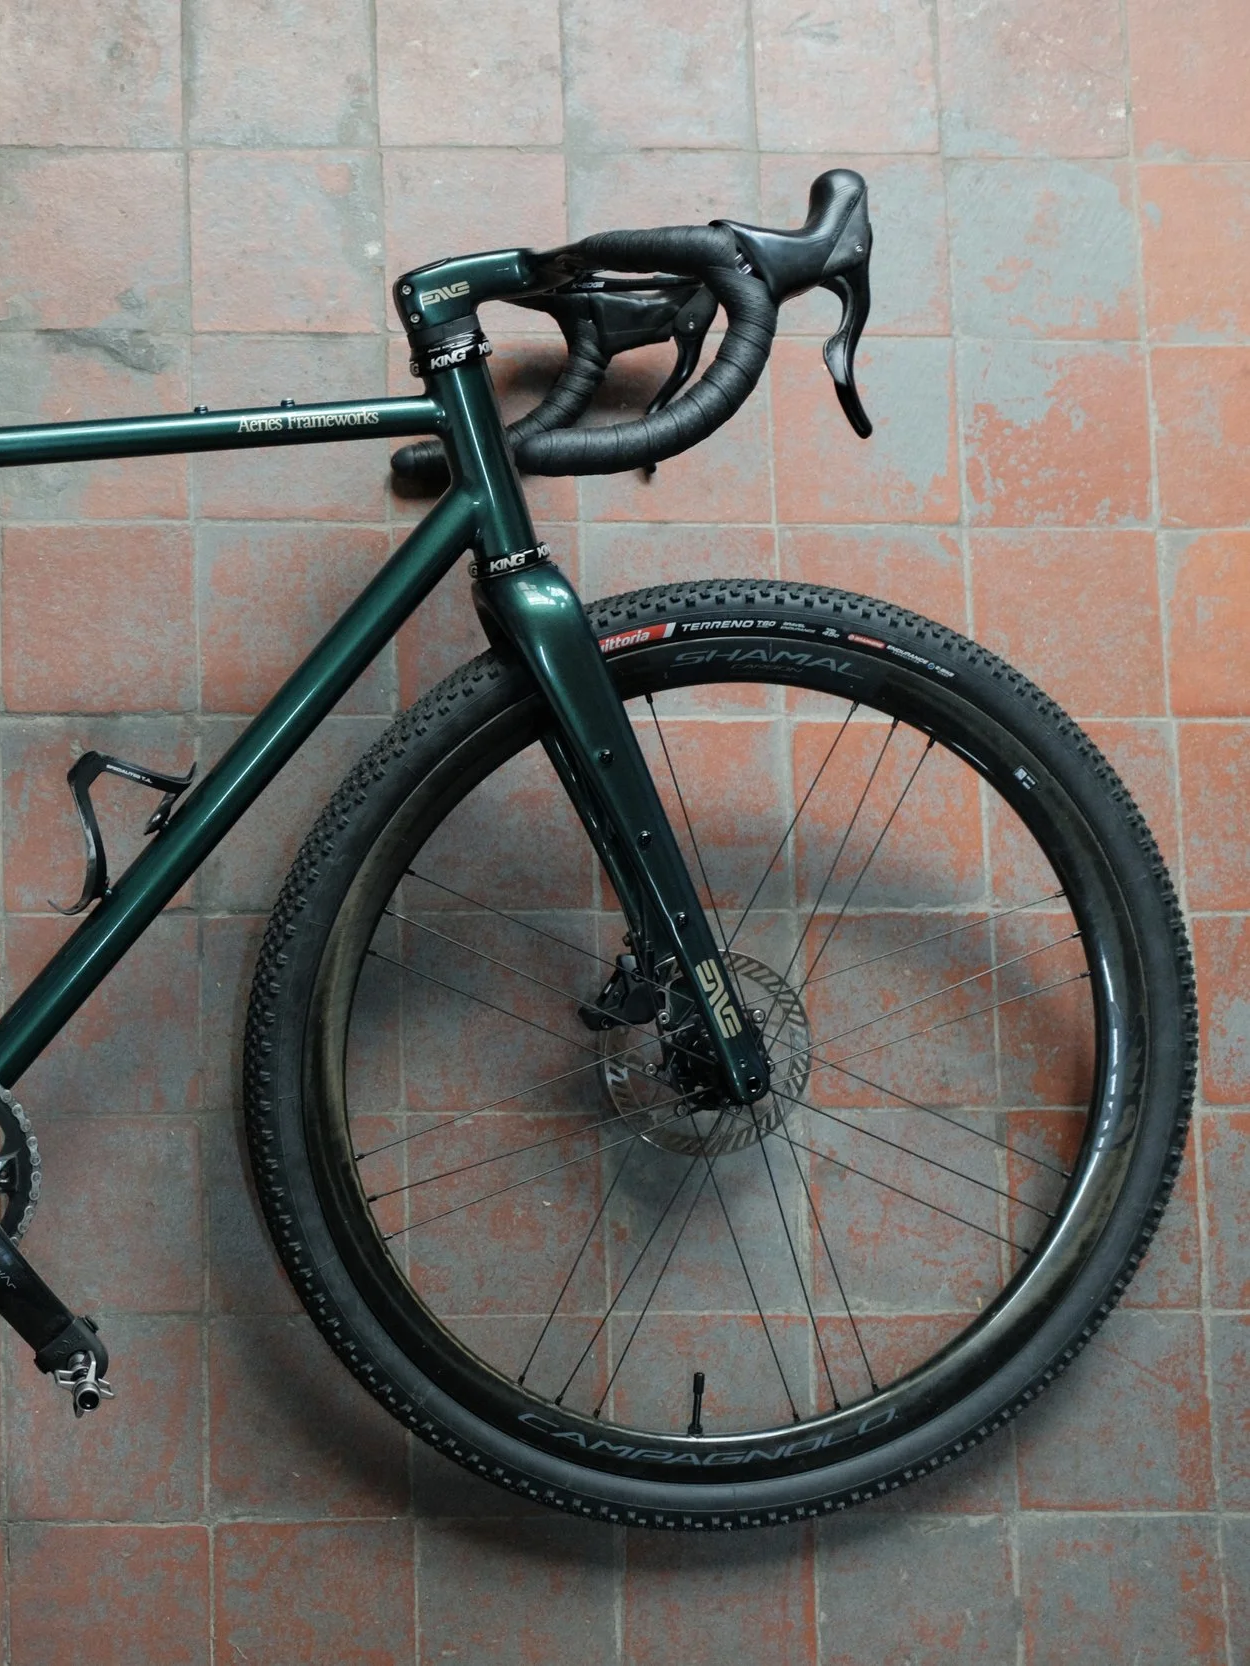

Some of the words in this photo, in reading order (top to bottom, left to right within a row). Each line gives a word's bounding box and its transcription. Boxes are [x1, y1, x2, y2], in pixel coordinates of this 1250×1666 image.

[430, 348, 467, 370] KING
[237, 416, 283, 433] Aeries
[287, 409, 379, 430] Frameworks
[490, 553, 525, 573] KING
[681, 620, 754, 632] TERRENO
[670, 649, 864, 679] SHAMAL
[517, 1407, 896, 1466] CAMPAGNOLO
